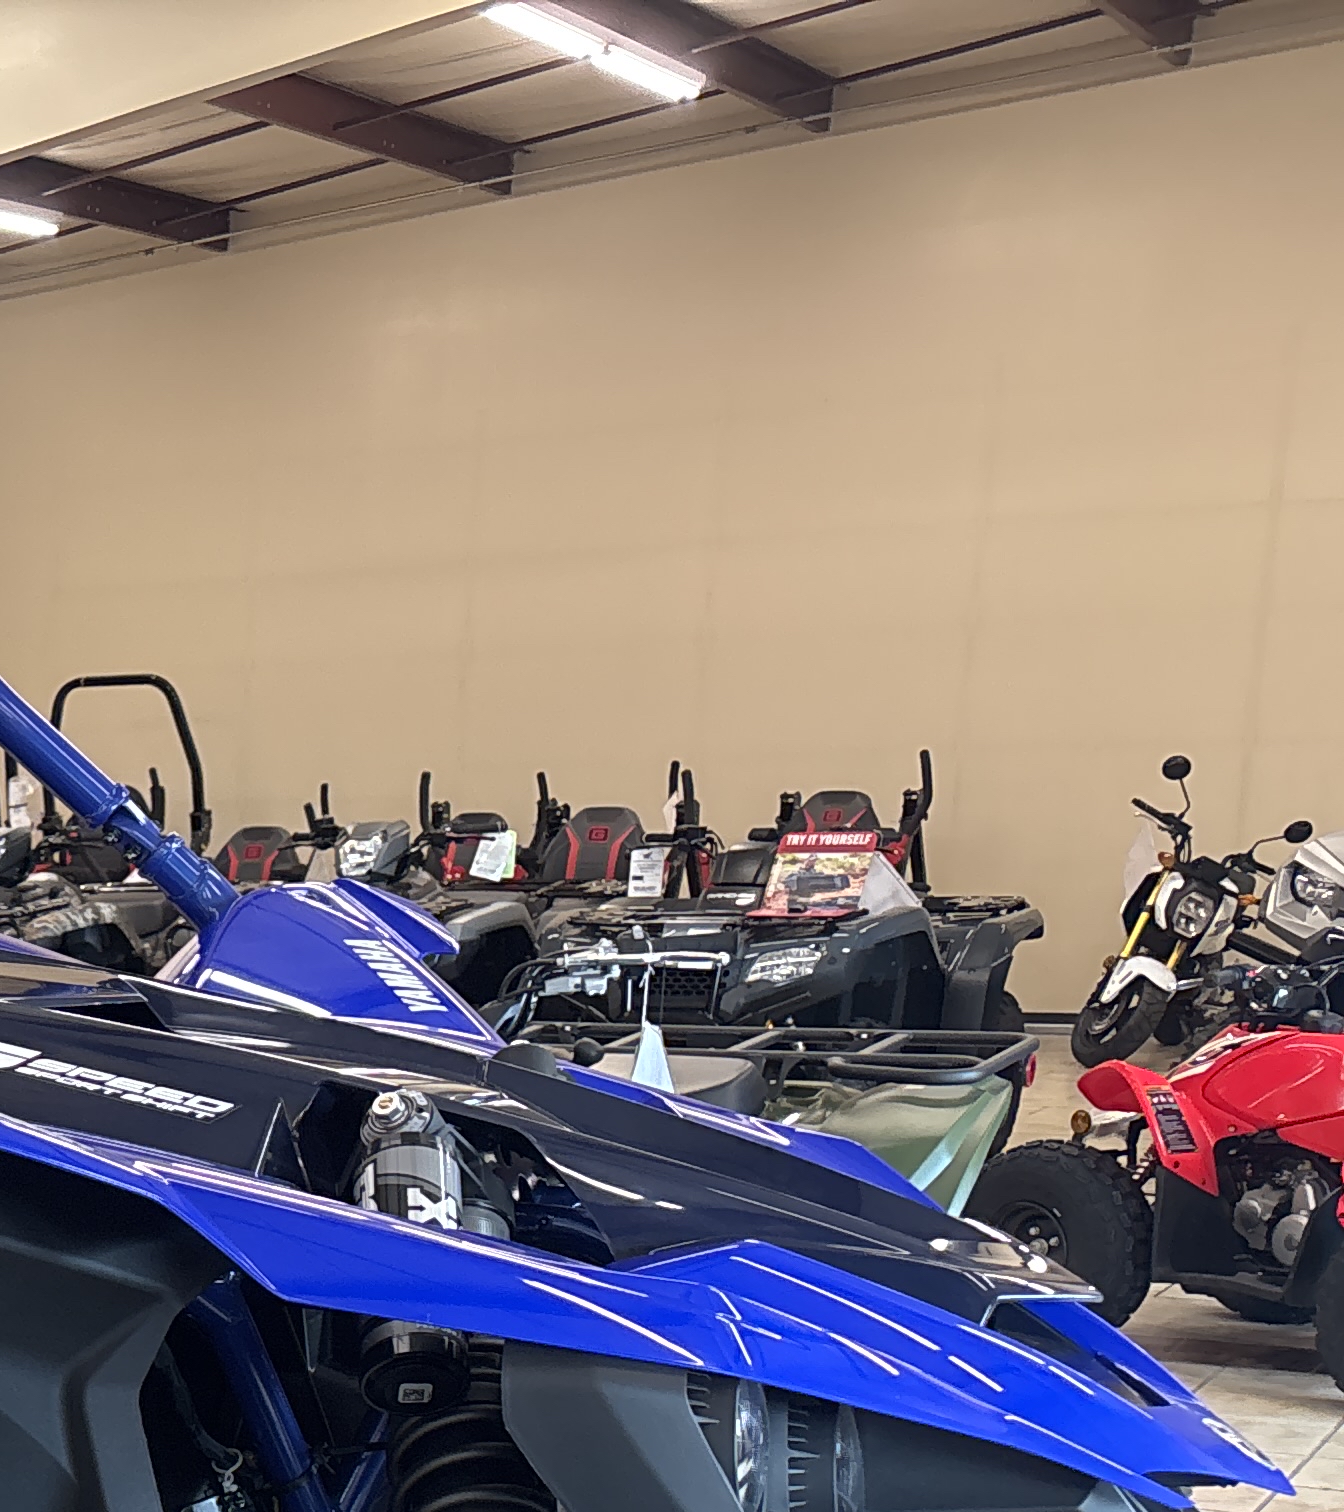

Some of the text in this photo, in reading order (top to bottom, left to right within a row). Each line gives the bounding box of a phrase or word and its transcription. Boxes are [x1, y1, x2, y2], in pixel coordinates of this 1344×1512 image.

[786, 833, 873, 846] TRY IT YOURSELF
[342, 938, 450, 1013] YAMAHA
[26, 1057, 236, 1115] SPEED
